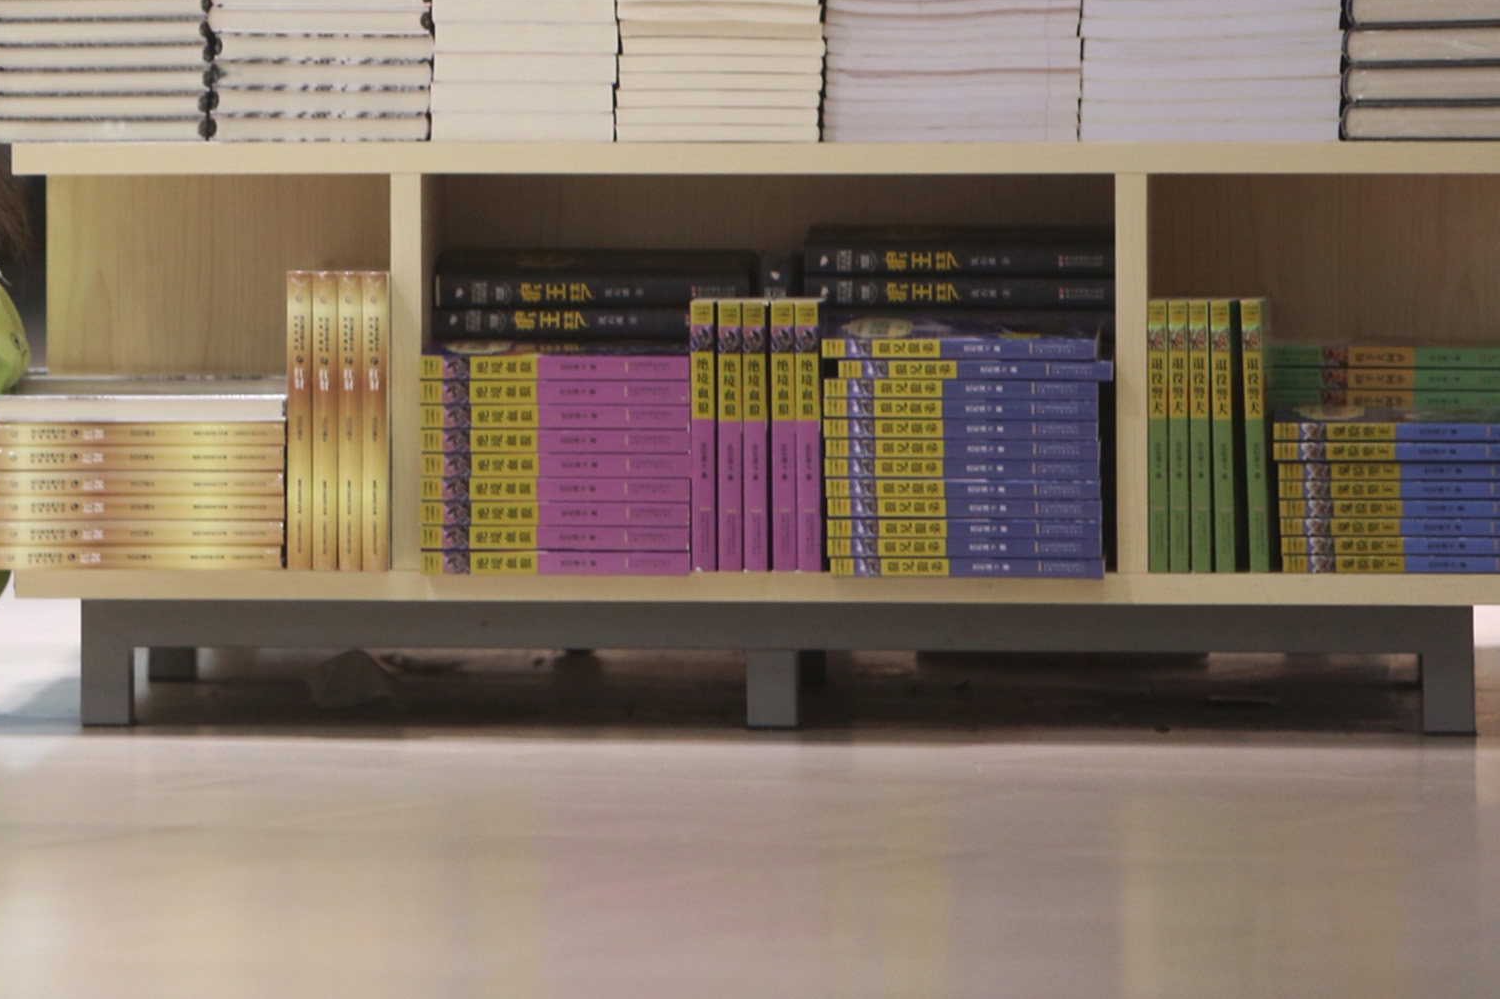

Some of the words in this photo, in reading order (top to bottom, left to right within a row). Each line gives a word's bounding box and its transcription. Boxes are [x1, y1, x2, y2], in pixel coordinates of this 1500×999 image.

[884, 251, 962, 270] 狼王梦
[513, 310, 590, 329] 狼王梦
[519, 282, 595, 302] 狼王梦
[885, 282, 962, 302] 狼王梦
[1152, 358, 1163, 413] 退役警犬
[1173, 358, 1184, 413] 退役警犬
[1194, 358, 1204, 413] 退役警犬
[1215, 359, 1227, 414] 退役警犬
[1247, 358, 1260, 413] 退役警犬
